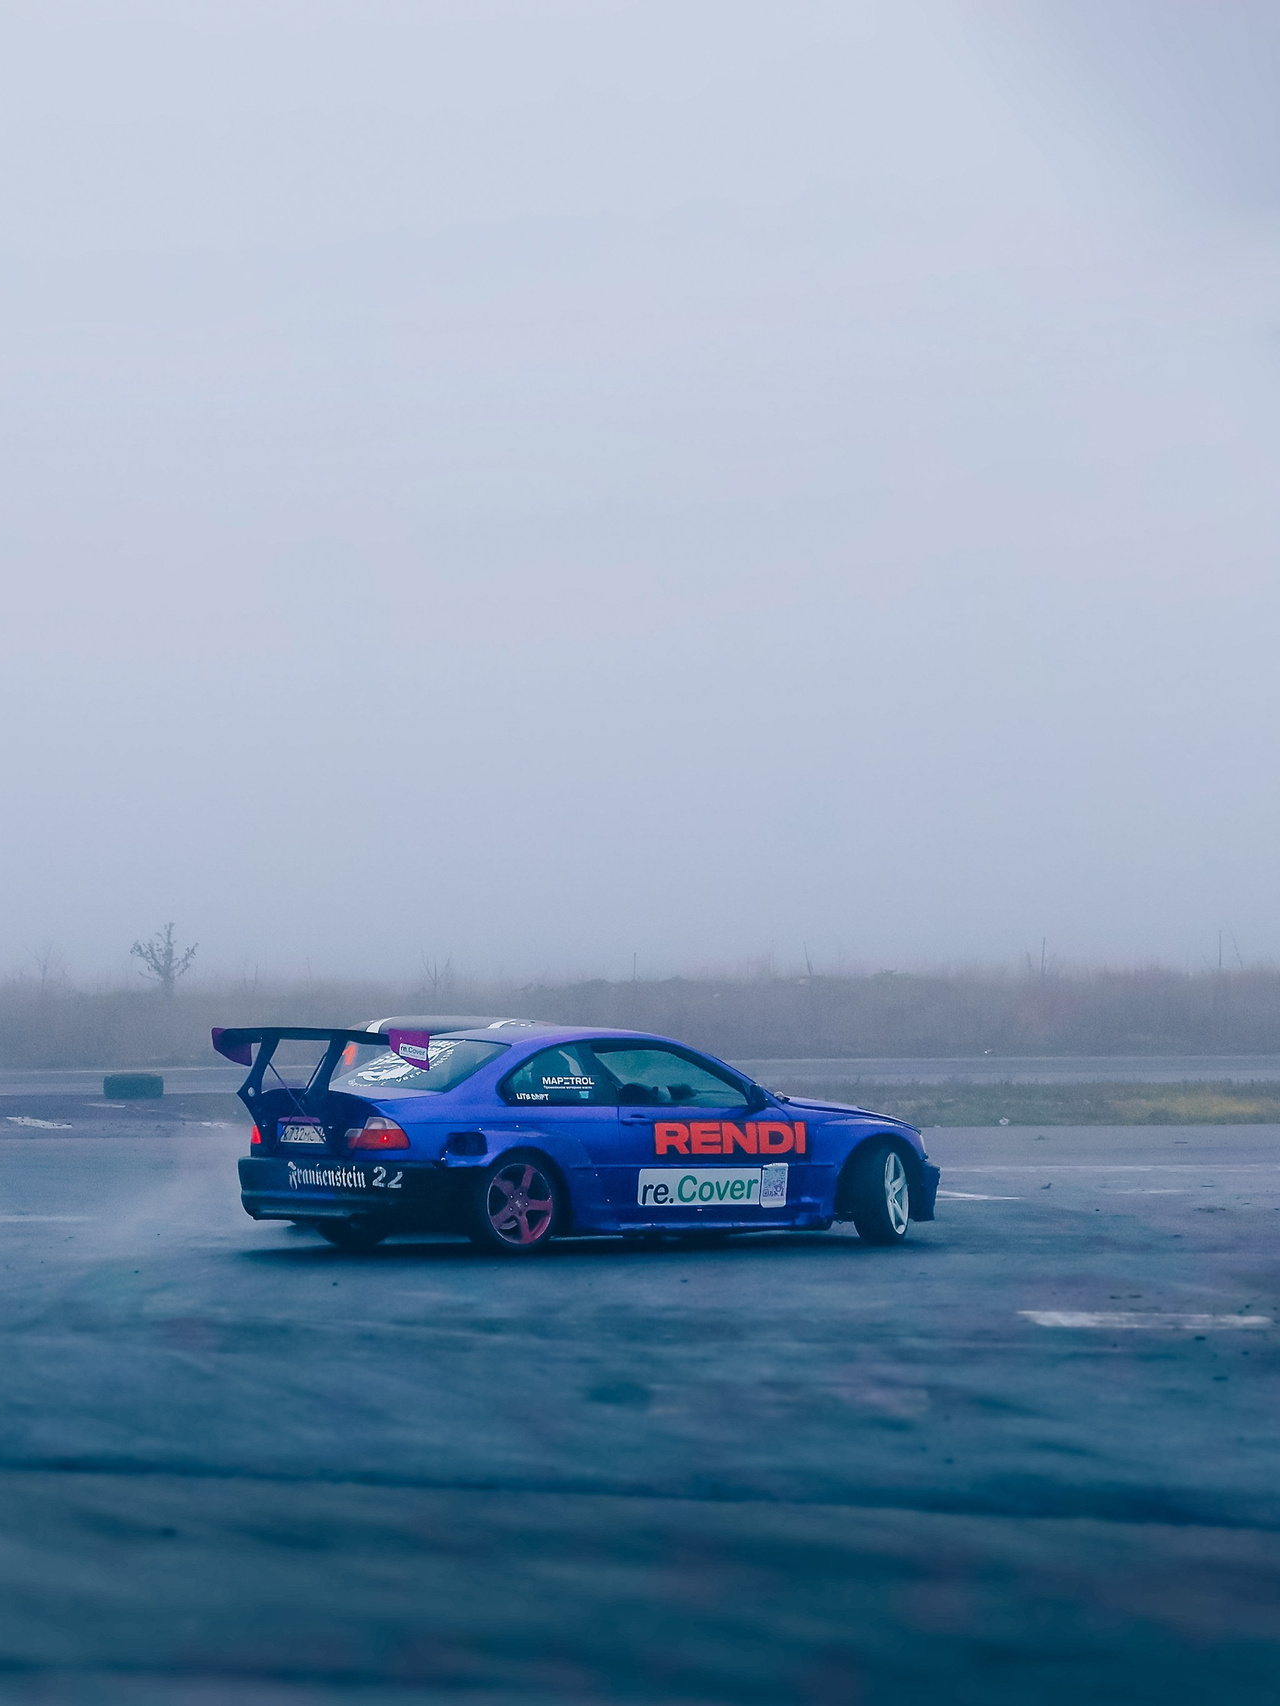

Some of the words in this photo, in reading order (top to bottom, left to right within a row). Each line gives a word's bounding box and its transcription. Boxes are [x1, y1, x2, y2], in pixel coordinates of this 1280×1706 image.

[654, 1122, 806, 1154] RENDI
[288, 1161, 366, 1190] Frankenstein
[372, 1166, 403, 1188] 22
[641, 1175, 759, 1205] re.Cover
